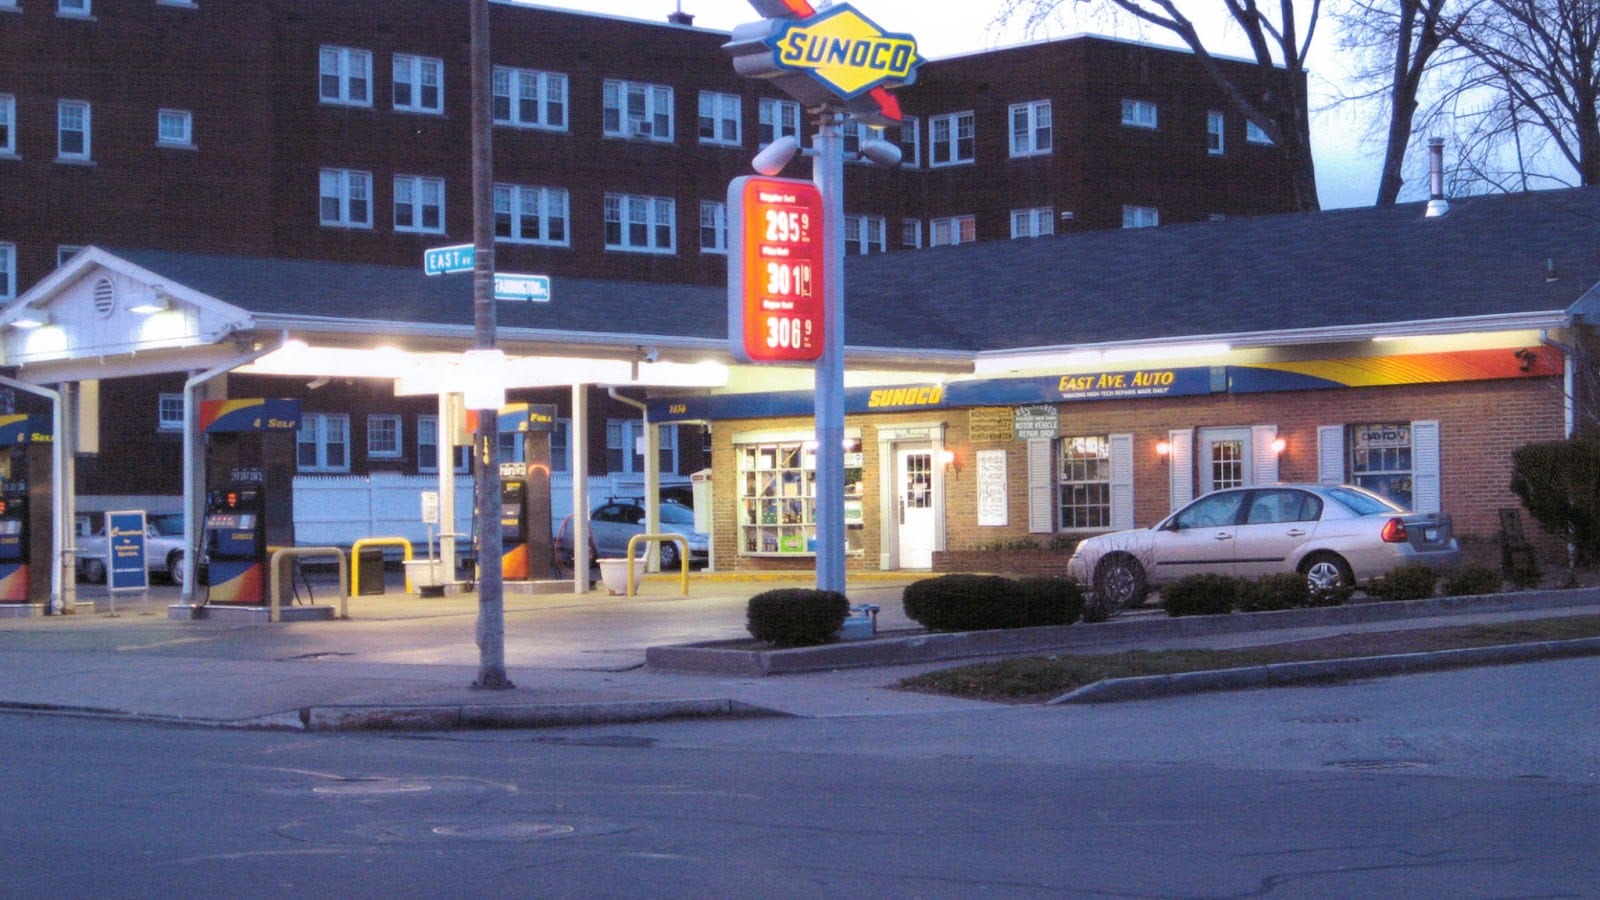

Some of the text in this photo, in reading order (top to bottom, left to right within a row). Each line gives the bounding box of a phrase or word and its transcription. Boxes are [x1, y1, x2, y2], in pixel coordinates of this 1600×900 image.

[783, 32, 913, 73] SUNOCO
[766, 209, 800, 242] 295
[429, 251, 460, 269] EAST
[767, 262, 800, 295] 301
[767, 317, 801, 349] 306
[1058, 371, 1175, 391] EAST AVE. AUTO
[868, 386, 943, 407] SUNOCO
[267, 418, 296, 428] SELF
[530, 413, 552, 422] FULL
[31, 432, 54, 442] SEL
